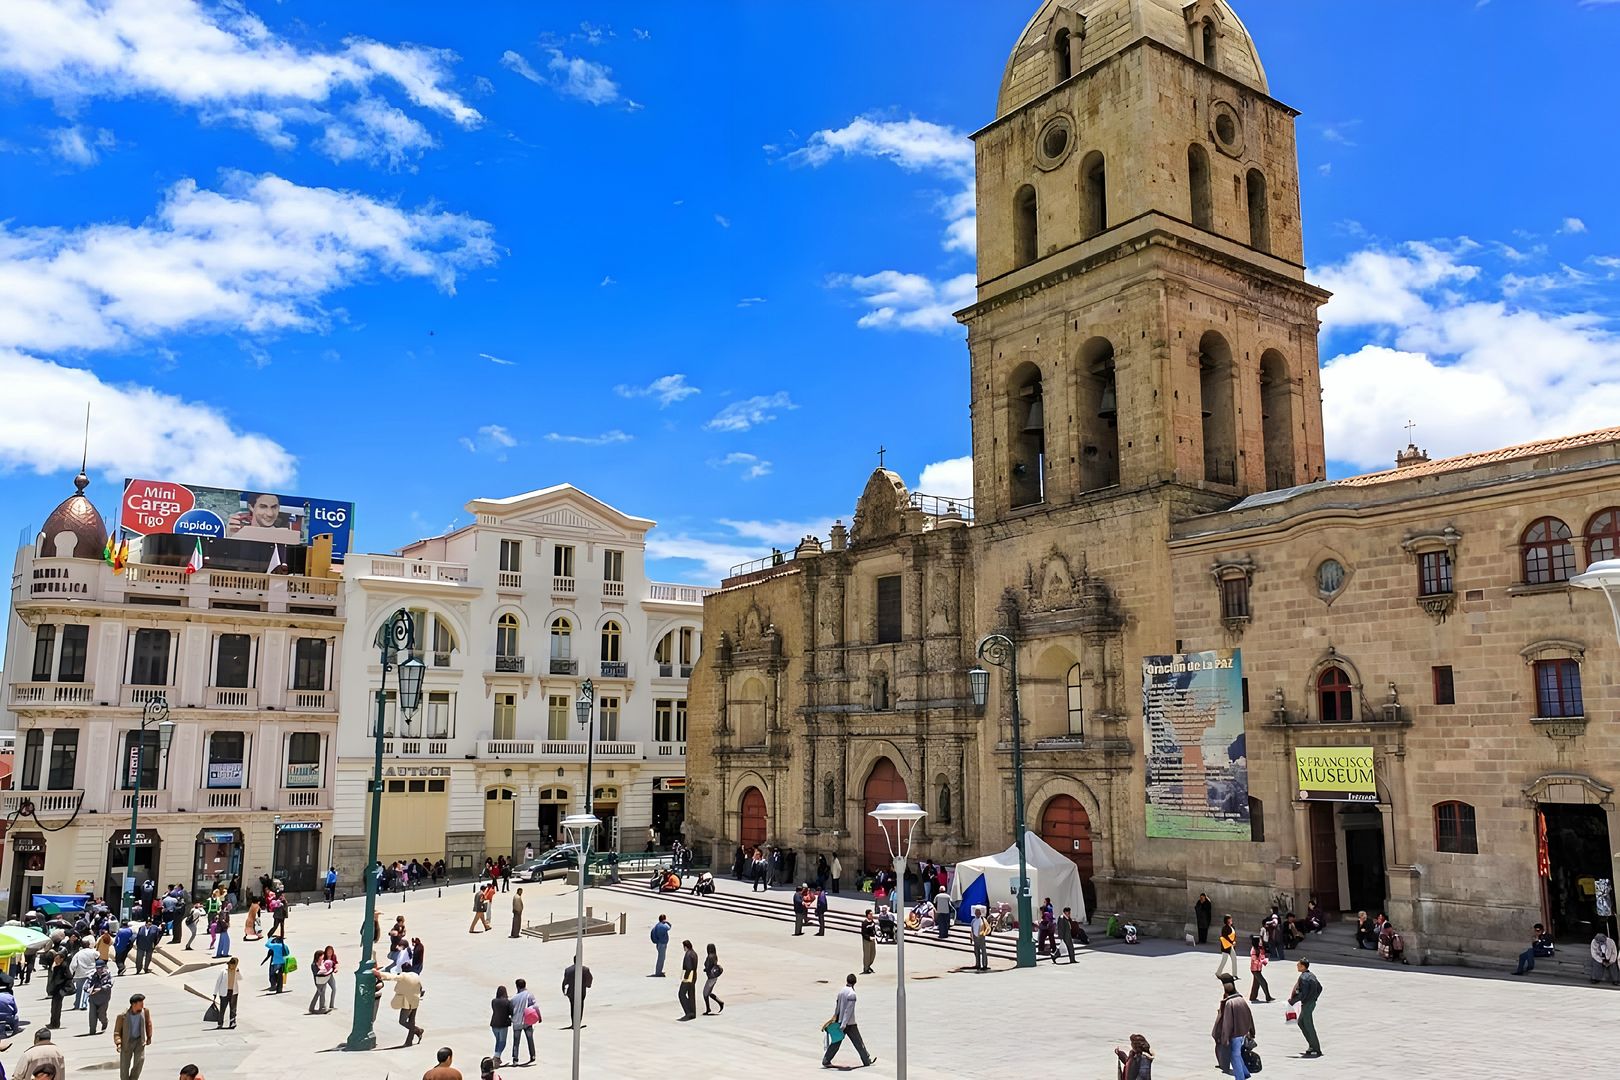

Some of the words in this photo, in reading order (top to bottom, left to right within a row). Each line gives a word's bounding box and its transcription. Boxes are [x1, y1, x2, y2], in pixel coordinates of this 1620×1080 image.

[144, 487, 176, 500] Mini
[127, 494, 181, 517] Carga
[136, 511, 164, 527] Tigo
[214, 524, 221, 533] y
[1187, 661, 1201, 672] de
[1307, 757, 1373, 768] FRANCISCO
[1300, 768, 1374, 783] MUSEUM
